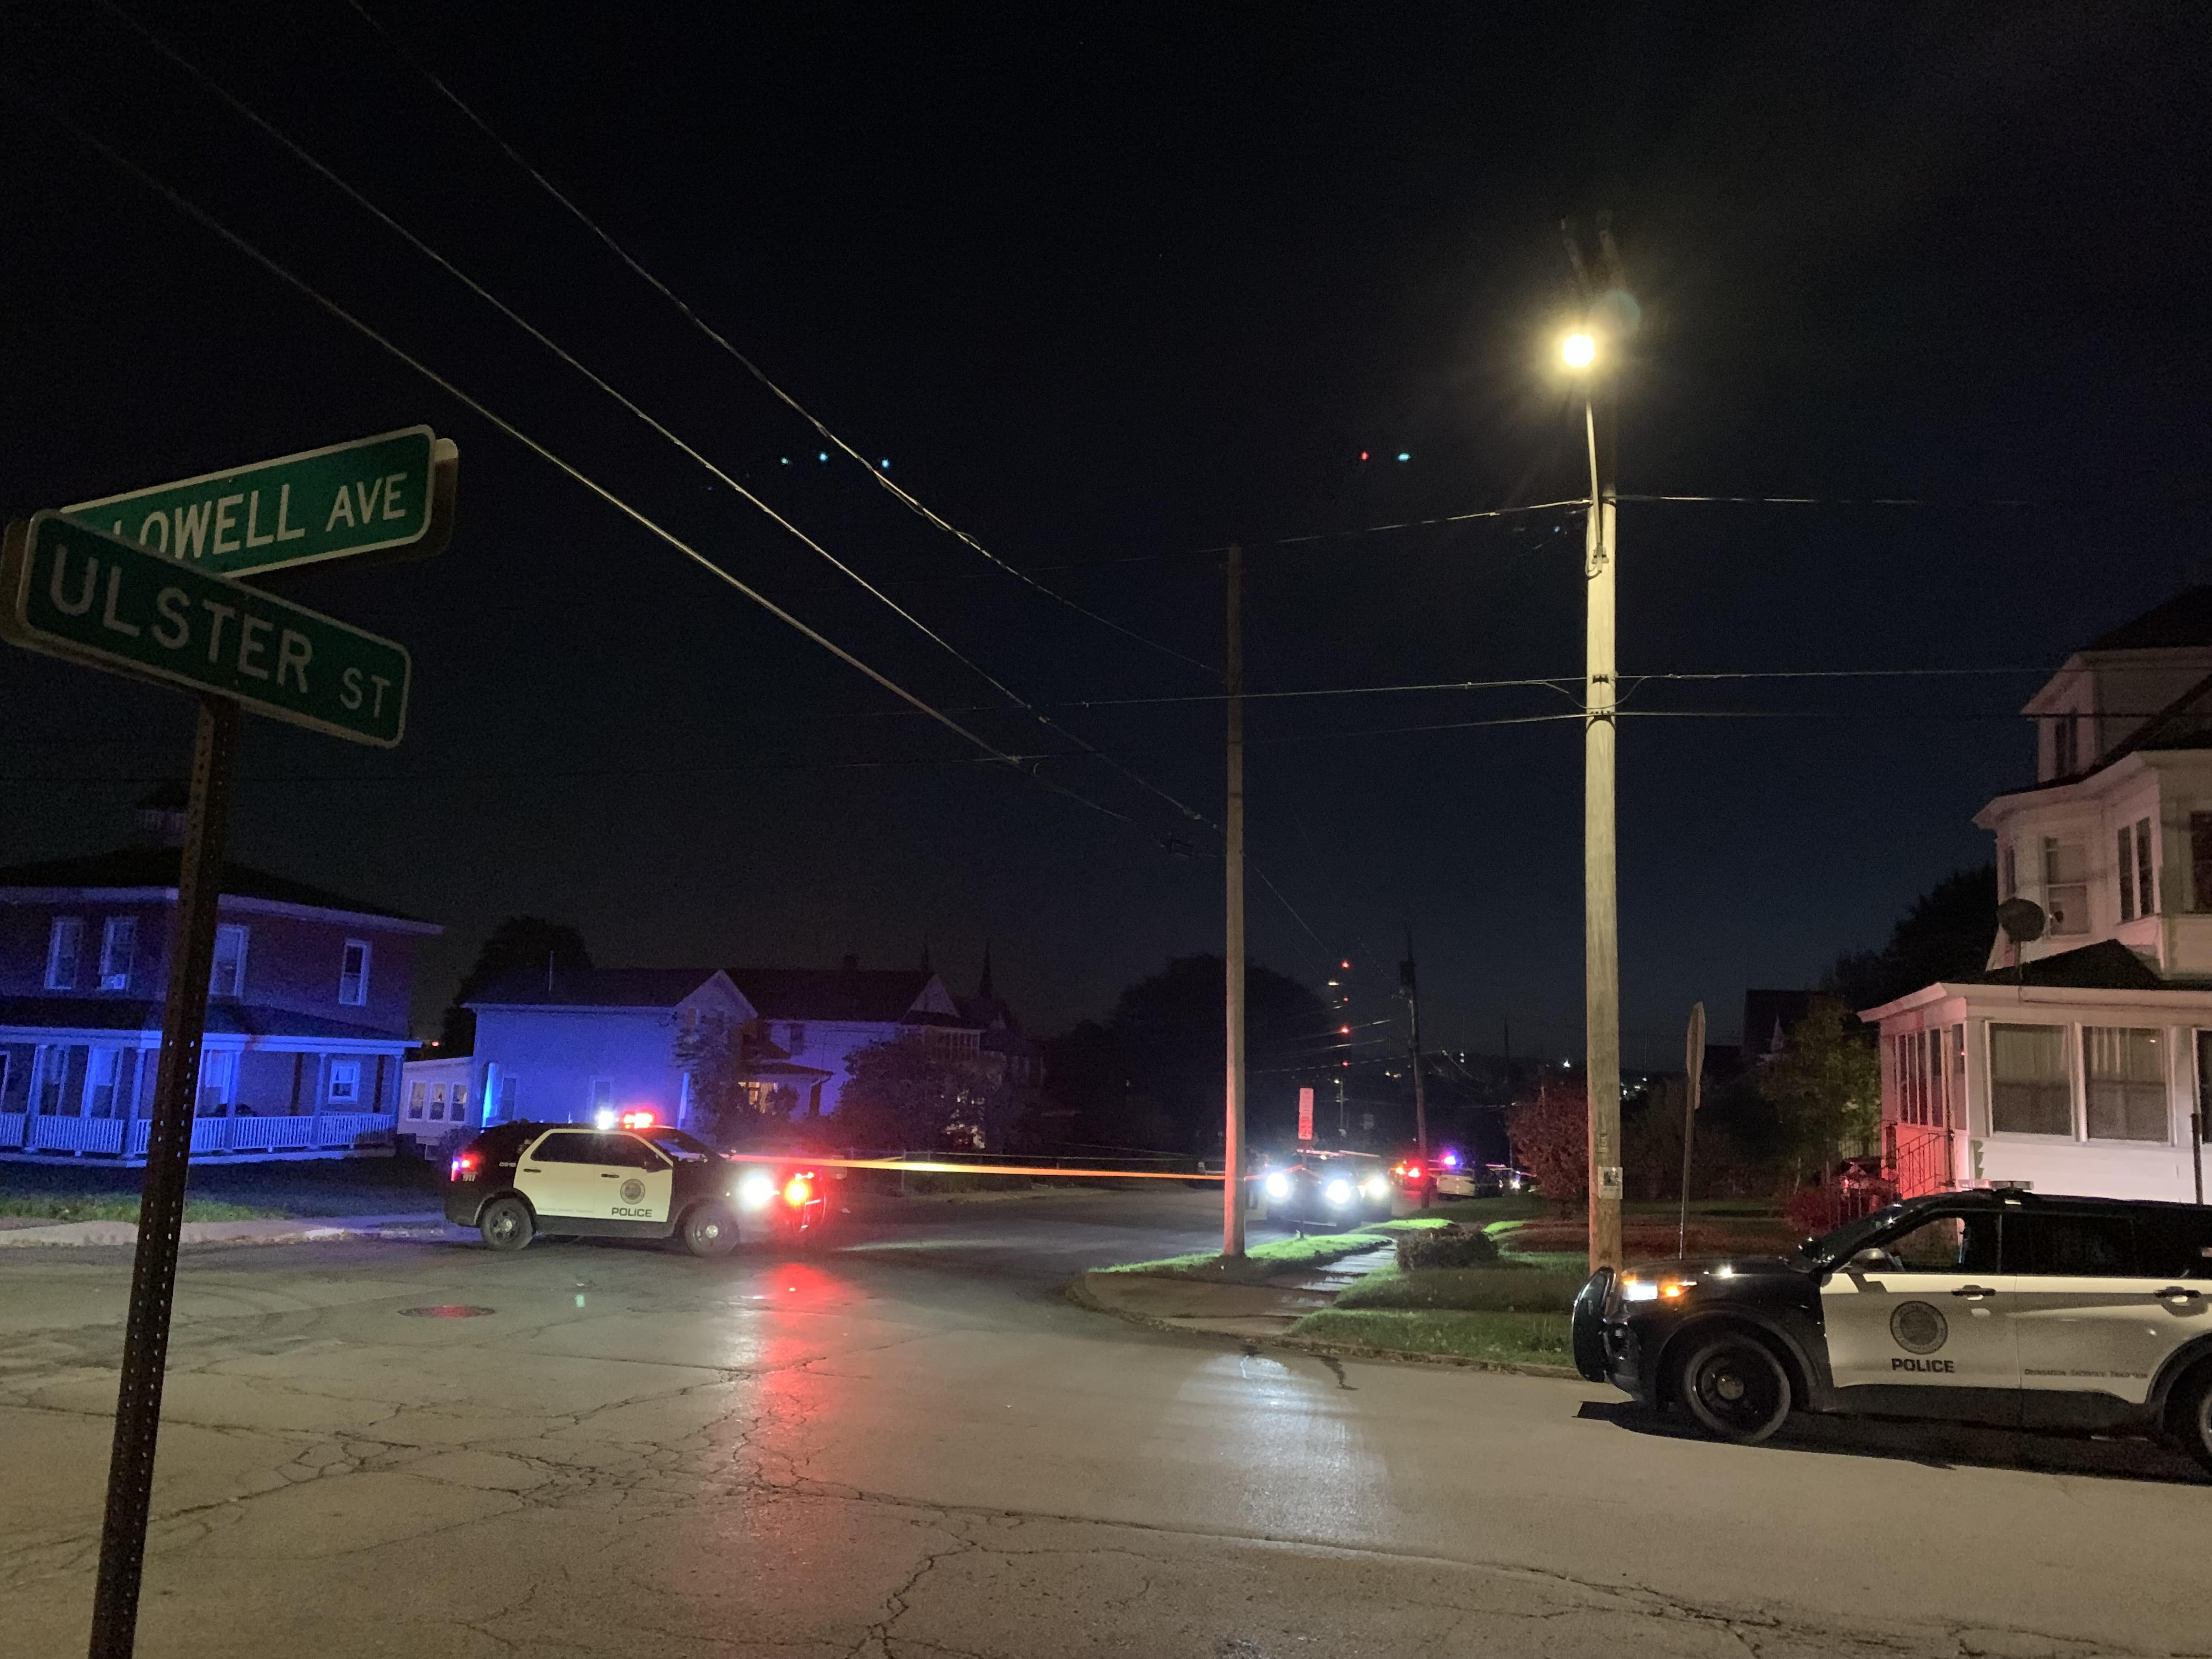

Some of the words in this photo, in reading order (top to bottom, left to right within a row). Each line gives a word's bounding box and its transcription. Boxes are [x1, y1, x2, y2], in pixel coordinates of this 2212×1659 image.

[114, 483, 306, 560] OWELL
[326, 472, 408, 532] AVE
[50, 543, 314, 693] ULSTER
[339, 667, 391, 718] ST
[611, 1207, 653, 1217] POLICE
[1891, 1358, 1955, 1373] POLICE
